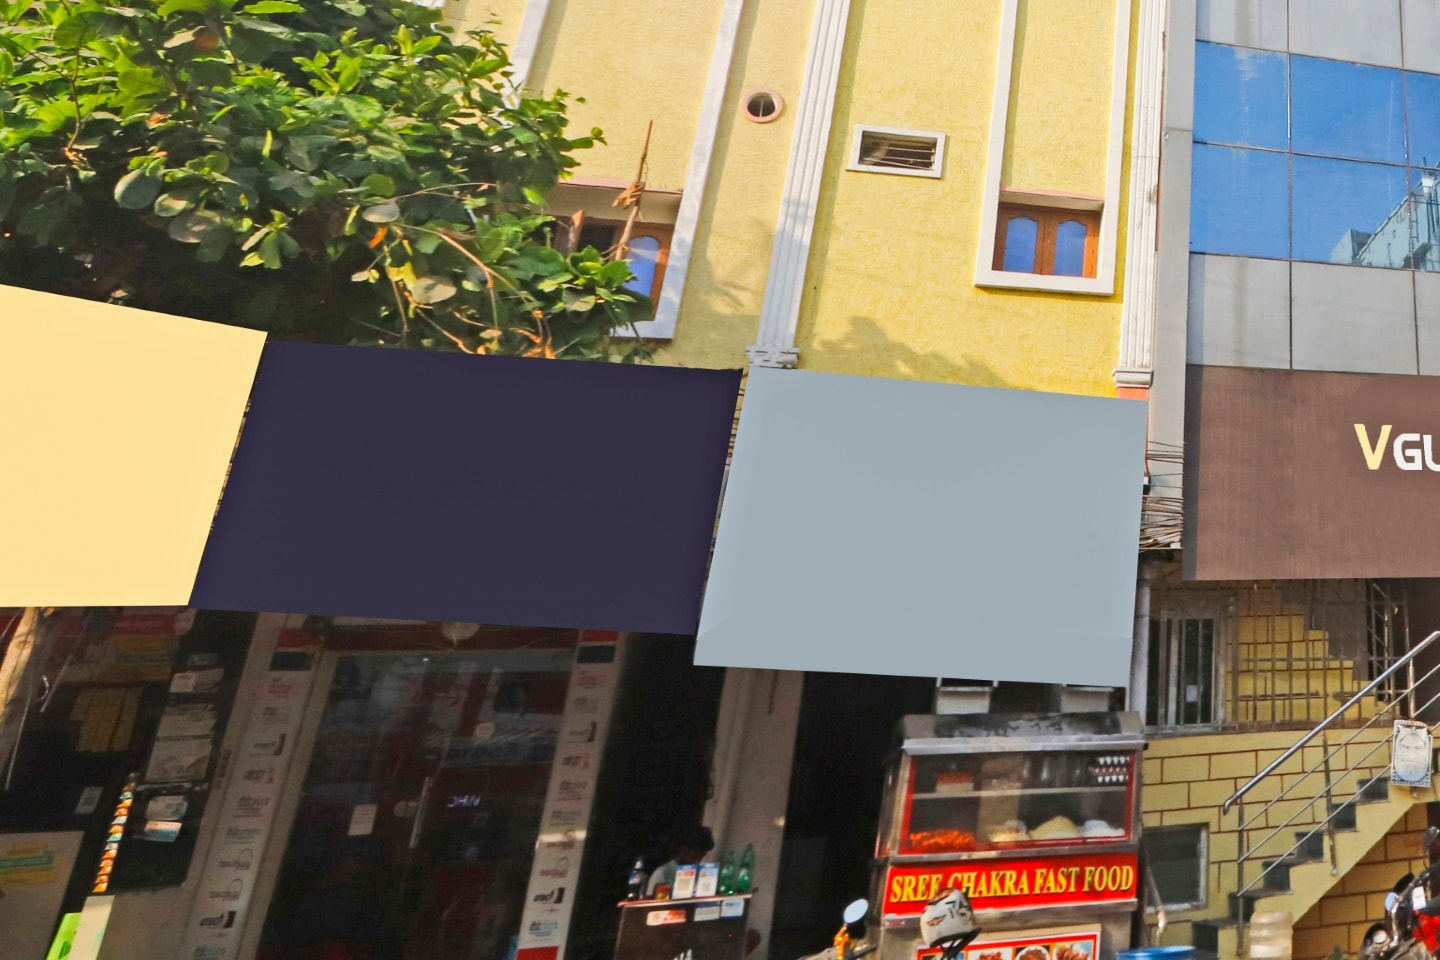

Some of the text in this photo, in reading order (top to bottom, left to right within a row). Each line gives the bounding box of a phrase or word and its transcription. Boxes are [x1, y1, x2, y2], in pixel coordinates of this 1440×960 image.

[890, 865, 1134, 902] SREE CHAKRA FAST FOOD
